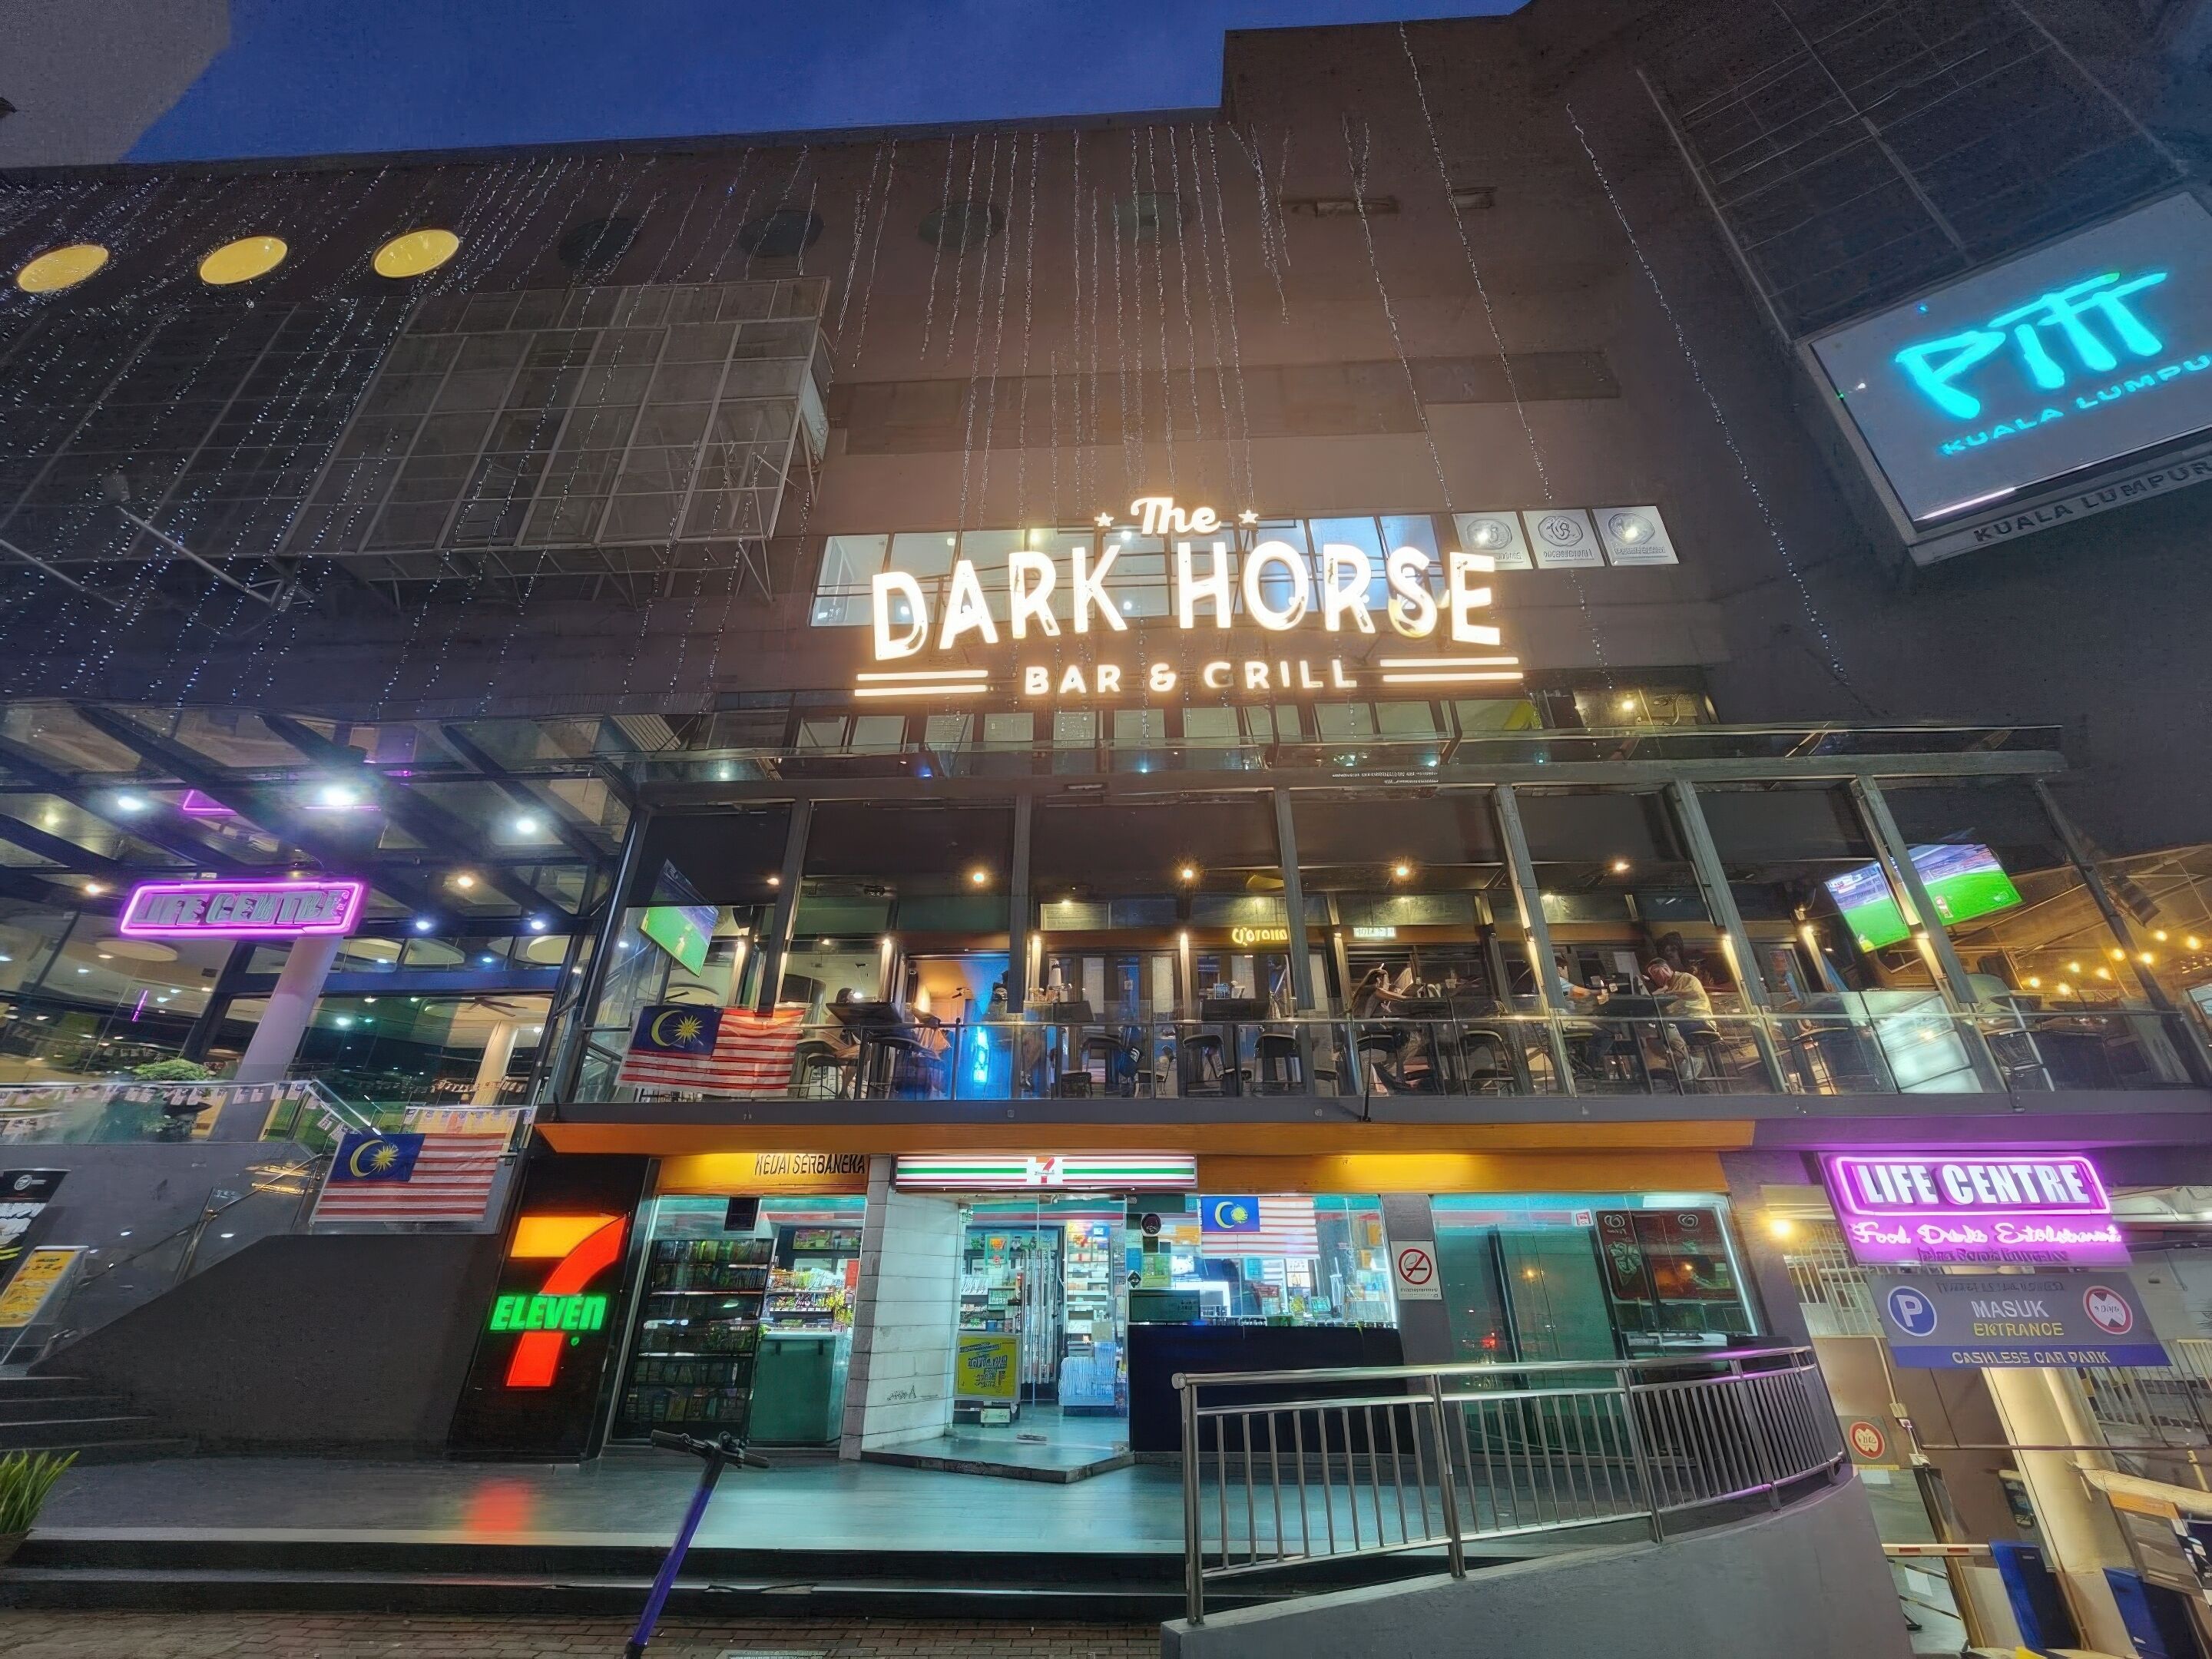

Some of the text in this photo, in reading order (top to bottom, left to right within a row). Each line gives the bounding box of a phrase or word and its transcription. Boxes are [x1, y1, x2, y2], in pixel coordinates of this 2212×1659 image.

[1939, 407, 2065, 456] KUALA
[1130, 496, 1222, 535] The
[1973, 461, 2212, 543] KUALA LUMPUR
[872, 540, 1501, 661] DARK HORSE
[1025, 658, 1358, 695] BAR & GRILL
[1856, 1164, 2091, 1205] LIFE CENTRE
[1971, 1300, 2050, 1318] MASUK
[1973, 1323, 2065, 1337] ENTRANCE
[1952, 1351, 2111, 1364] CASHLESS CAR PARK
